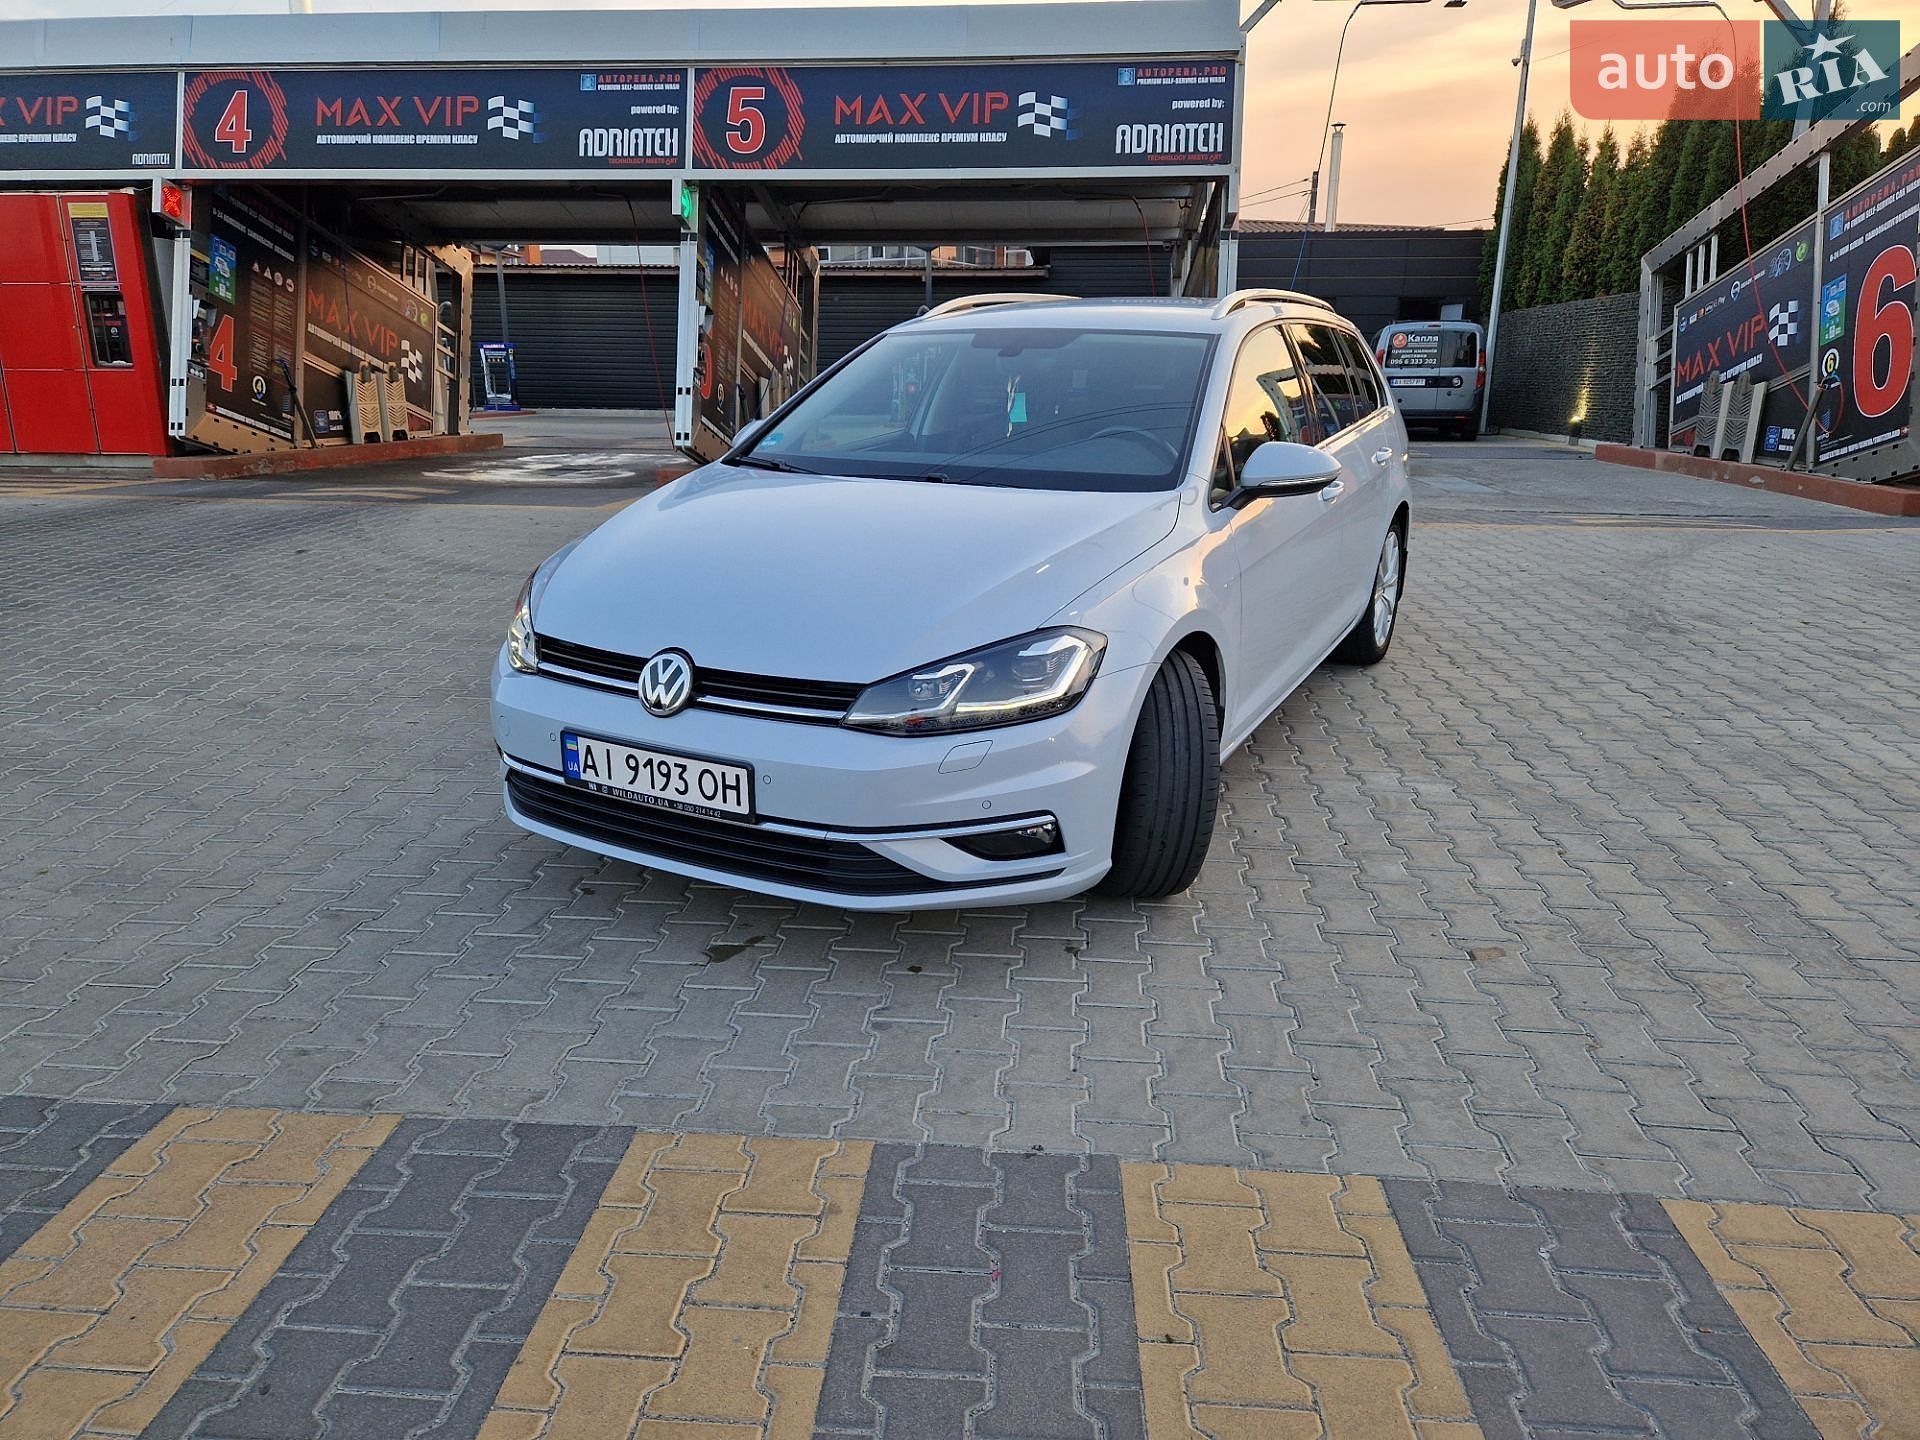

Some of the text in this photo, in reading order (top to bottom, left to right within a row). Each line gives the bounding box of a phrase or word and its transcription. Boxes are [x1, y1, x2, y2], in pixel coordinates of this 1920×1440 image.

[16, 96, 79, 126] VIP
[316, 96, 480, 127] MAX VIP
[631, 104, 680, 115] powered by:
[834, 92, 1010, 126] MAX VIP
[1172, 98, 1225, 110] powered by:
[214, 90, 252, 154] 4
[725, 86, 766, 154] 5
[895, 132, 940, 143] КОМПЛЕКС
[307, 287, 358, 339] MAX
[363, 316, 398, 356] VIP
[1853, 244, 1918, 418] 6
[208, 313, 238, 393] 4
[1408, 334, 1439, 342] Капля
[1676, 312, 1766, 388] MAX VIP
[1826, 352, 1836, 374] 6
[567, 760, 579, 772] UA
[582, 744, 742, 807] AI 9193 OH
[612, 787, 669, 807] WILDAUTO.UA
